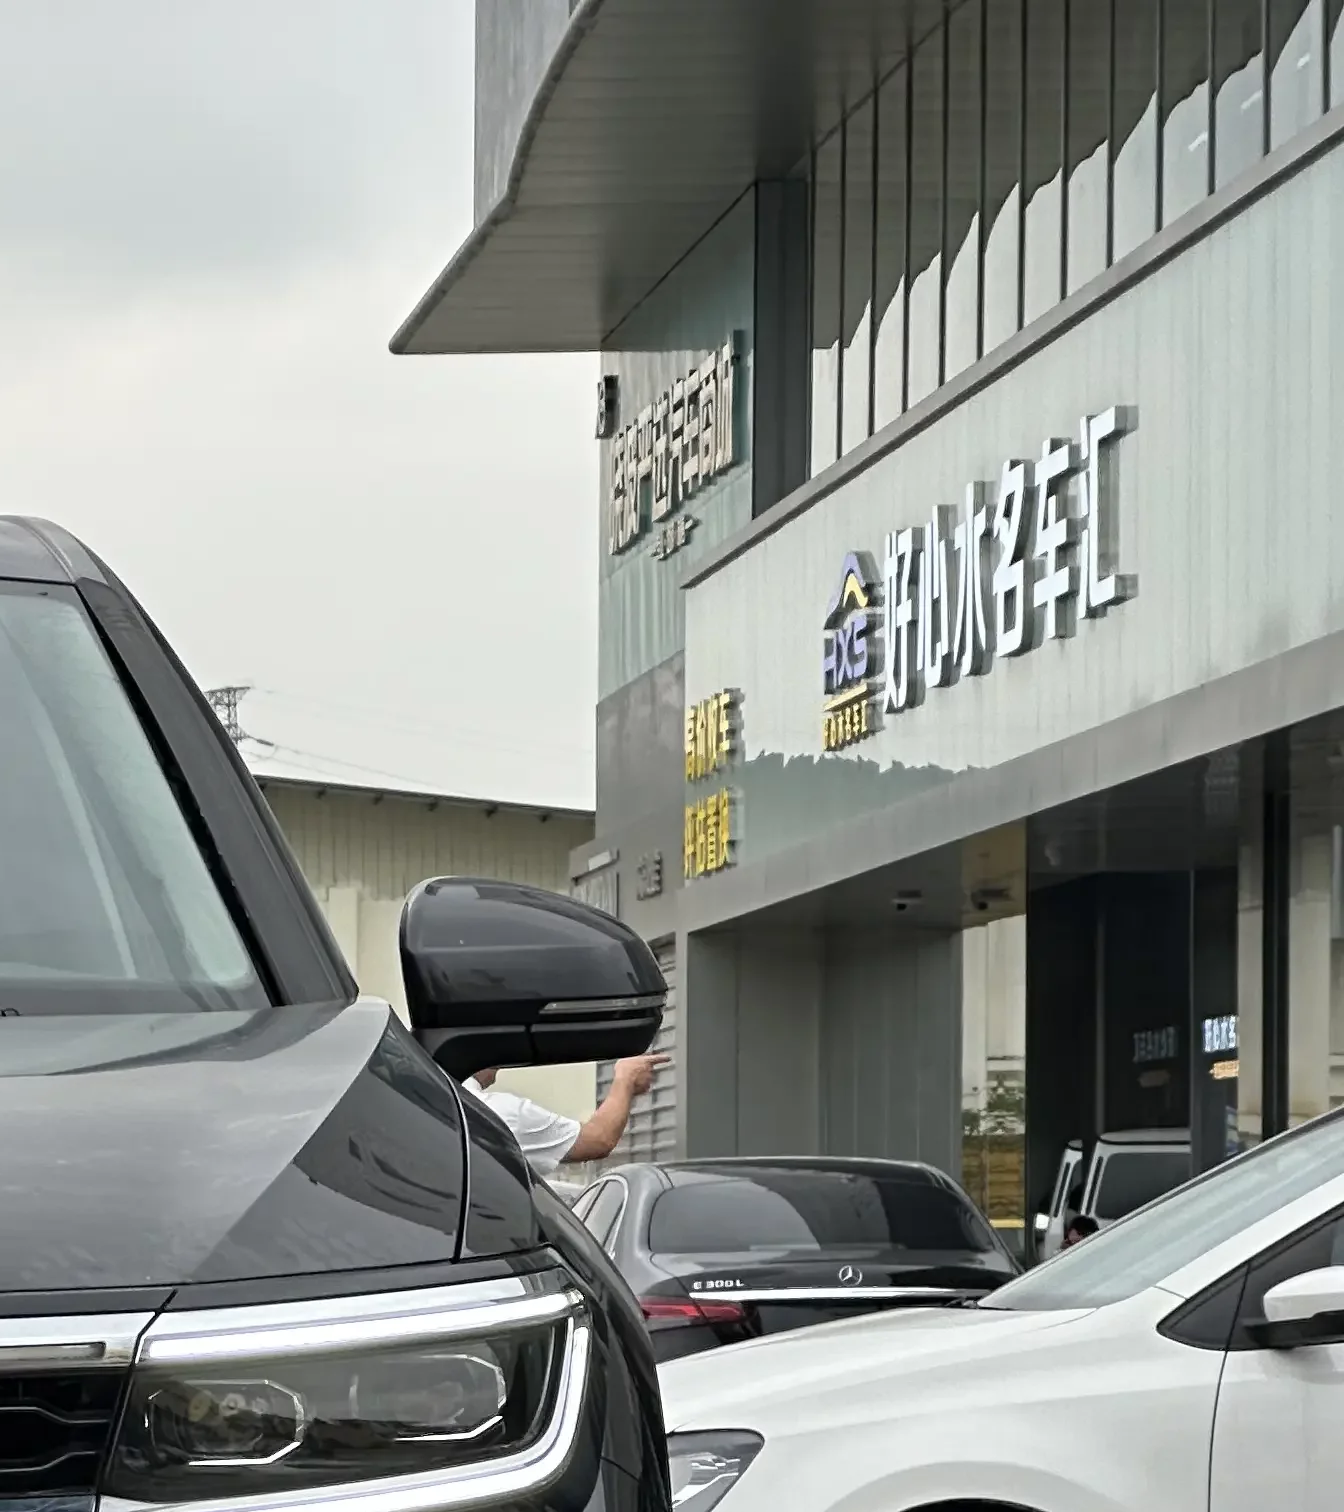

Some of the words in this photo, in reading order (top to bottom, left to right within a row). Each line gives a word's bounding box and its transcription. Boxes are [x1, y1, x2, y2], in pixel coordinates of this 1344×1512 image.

[883, 405, 1118, 712] 好心水名车汇
